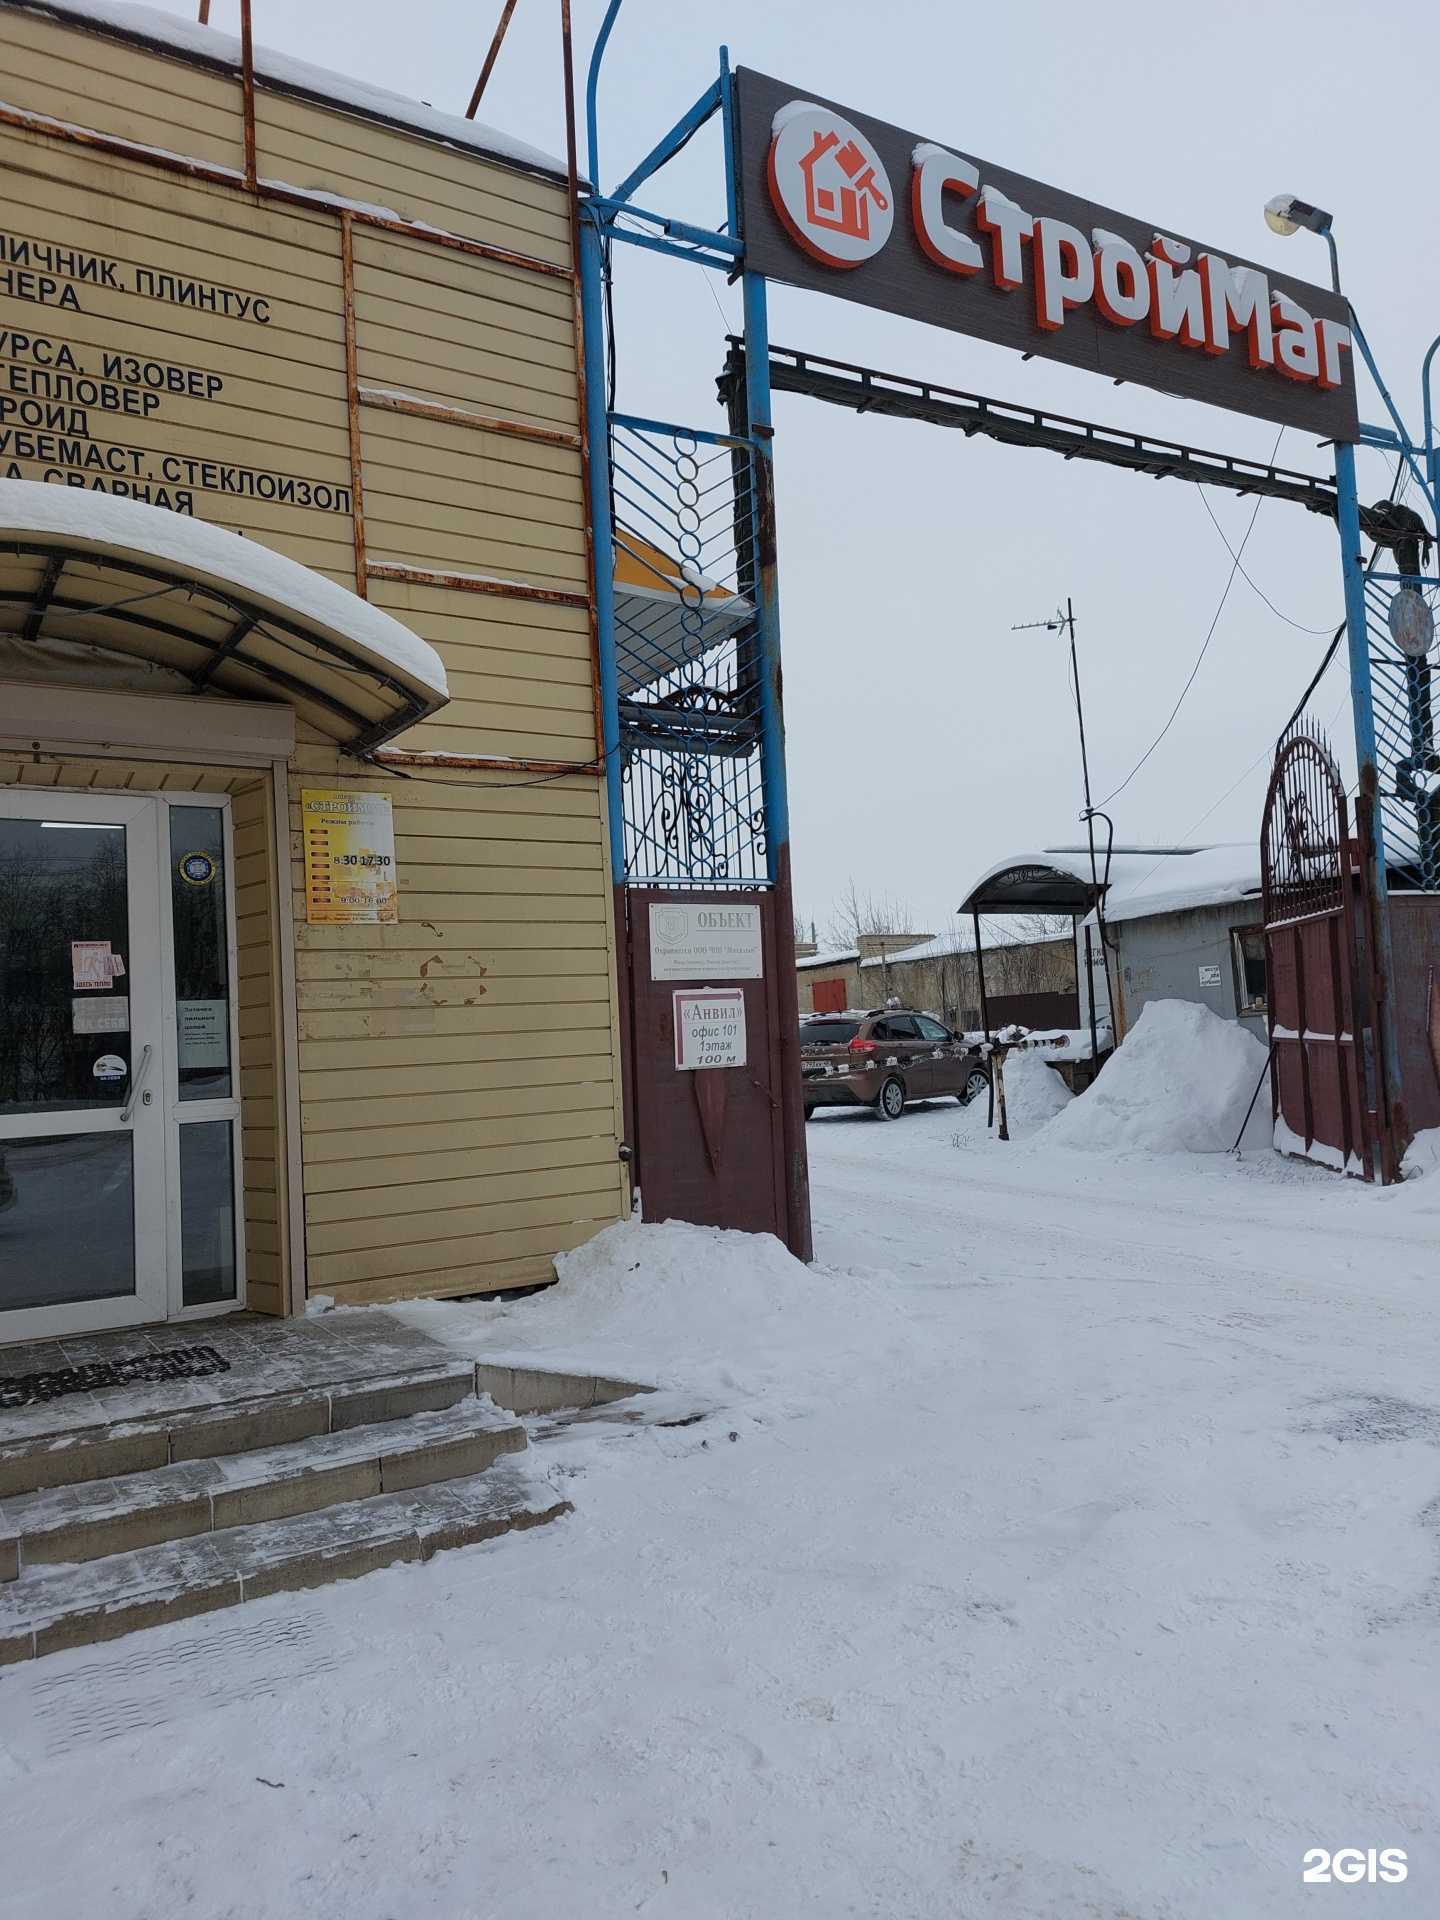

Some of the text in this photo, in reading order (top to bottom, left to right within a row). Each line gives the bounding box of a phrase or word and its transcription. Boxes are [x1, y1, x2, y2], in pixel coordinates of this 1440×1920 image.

[912, 143, 1351, 390] СтройМаг
[136, 268, 271, 324] ПЛИНТУС
[103, 353, 224, 399] ИЗОВЕР
[162, 457, 350, 513] СТЕКЛОИЗОЛ
[697, 911, 754, 928] ОБЪЕКТ
[691, 1024, 737, 1040] офис 101
[697, 1054, 722, 1065] 100
